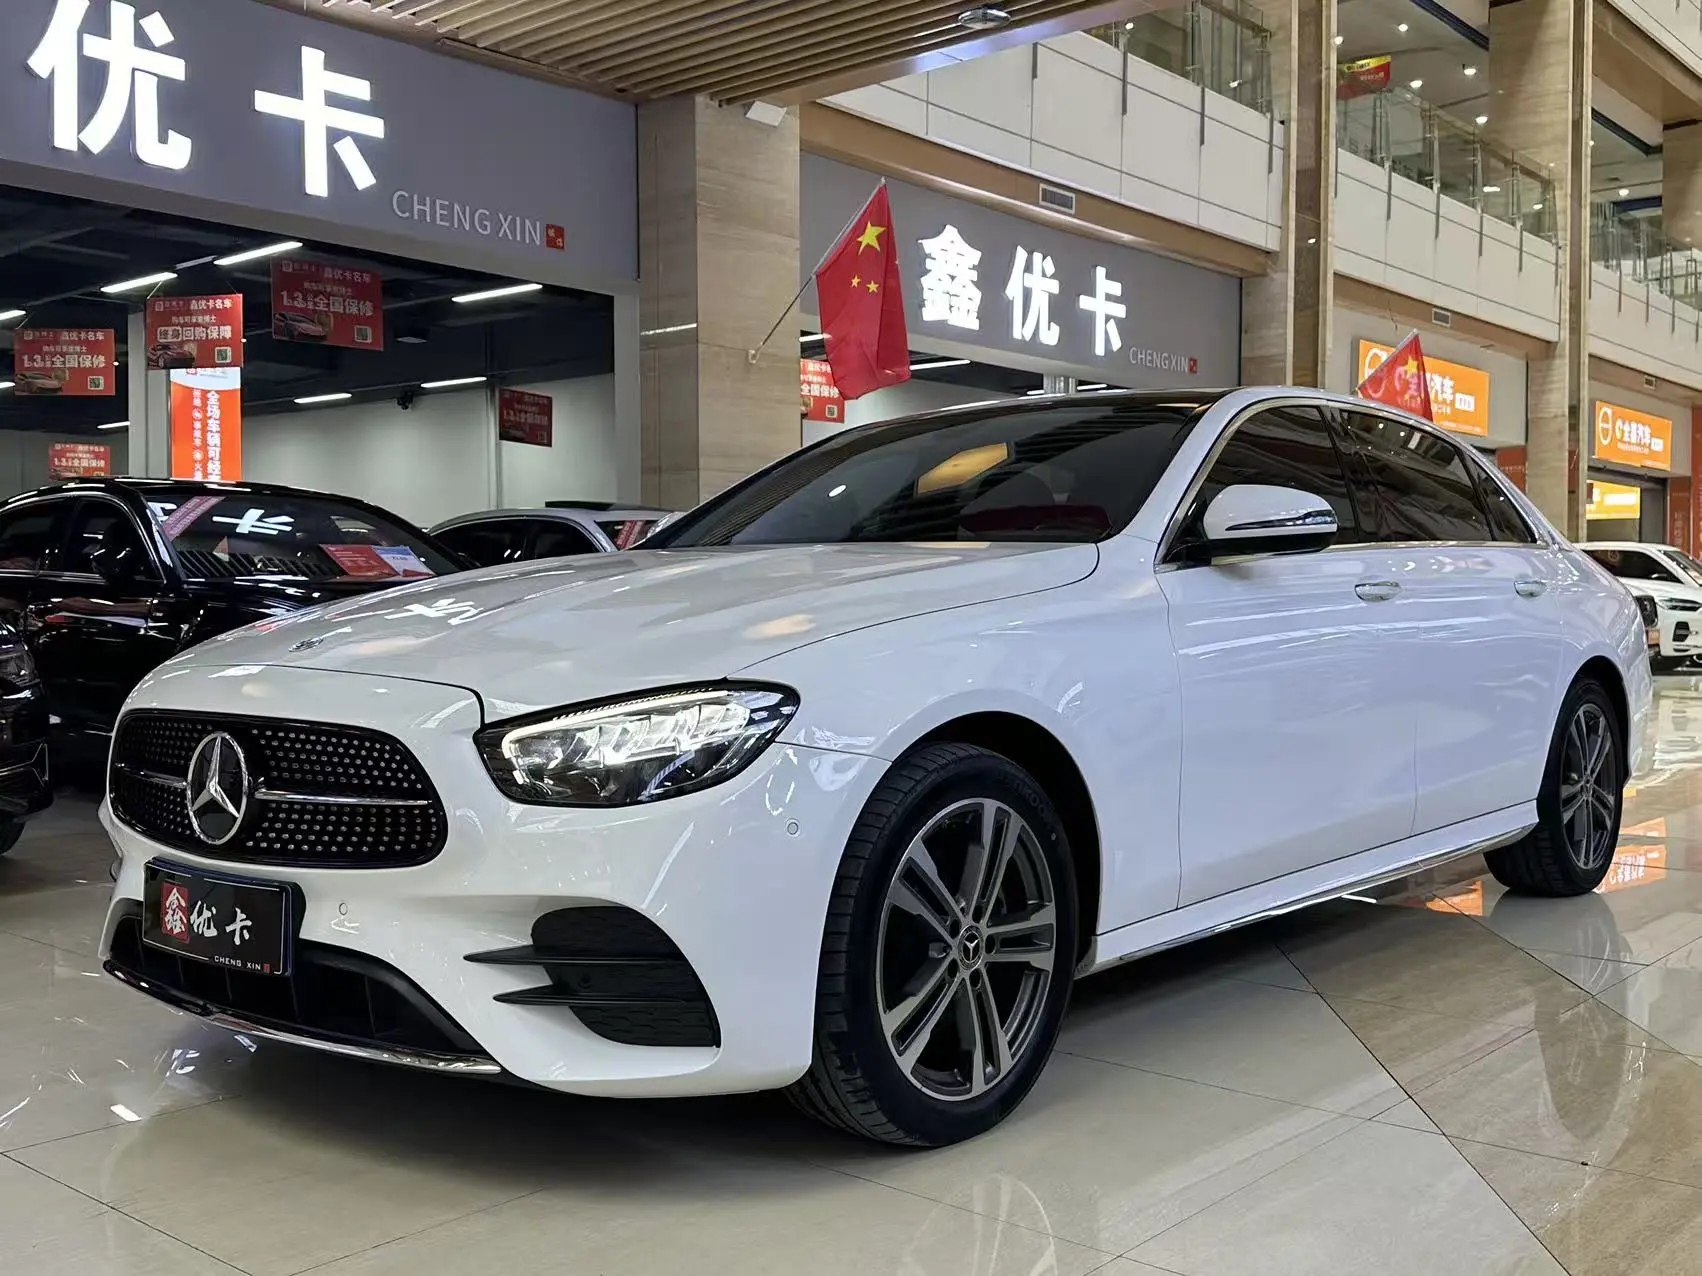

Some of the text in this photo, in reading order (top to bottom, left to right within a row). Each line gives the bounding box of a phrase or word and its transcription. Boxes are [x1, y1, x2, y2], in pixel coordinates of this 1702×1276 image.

[391, 190, 491, 235] CHENG
[498, 213, 541, 246] XIN
[917, 224, 1127, 356] 鑫优卡
[1129, 346, 1169, 369] CHENG
[1170, 353, 1189, 373] XIN
[164, 887, 253, 946] 鑫优卡
[214, 955, 262, 972] CHENG XIN
